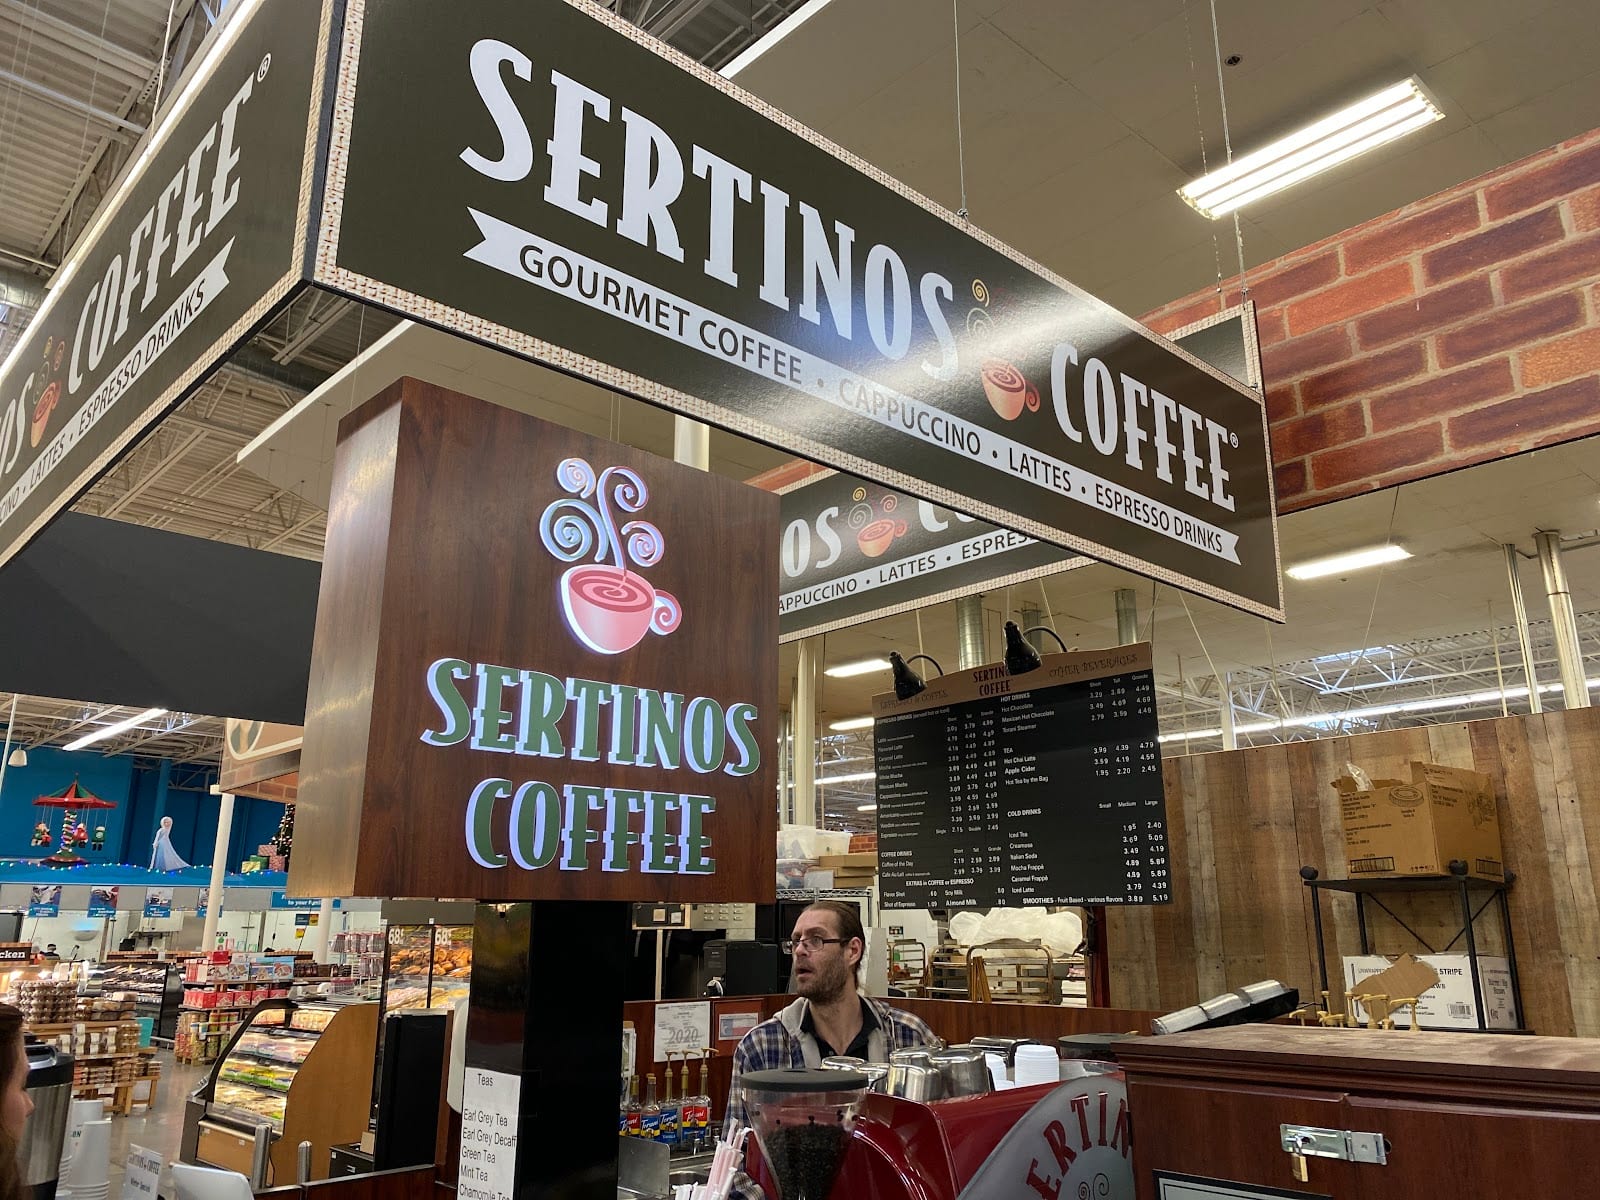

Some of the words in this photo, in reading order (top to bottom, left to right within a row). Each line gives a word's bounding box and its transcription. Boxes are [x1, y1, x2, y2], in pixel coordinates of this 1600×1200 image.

[459, 39, 960, 381] SERTINOS
[30, 433, 66, 490] LATTES
[79, 350, 141, 435] ESPRESSO
[145, 279, 206, 365] DRINKS
[519, 245, 690, 337] GOURMET
[699, 319, 803, 385] COFFEE
[838, 378, 981, 456] CAPPUCCINO
[1009, 447, 1072, 493] LATTES
[1096, 483, 1170, 532] ESPRESSO
[1174, 517, 1223, 554] DRINKS
[879, 554, 936, 583] LATTES
[979, 680, 1011, 697] COFFEE
[1001, 694, 1011, 702] HOT
[1011, 692, 1031, 701] DRINKS
[1010, 703, 1034, 712] Chocolate
[1135, 684, 1150, 692] 4.49
[420, 657, 760, 777] SERTINOS
[1001, 715, 1021, 724] Mexican
[1031, 710, 1055, 719] Chocolate
[1089, 702, 1104, 710] 3.49
[1136, 696, 1151, 704] 4.69
[1017, 723, 1037, 732] Steamer
[1137, 707, 1152, 715] 4.49
[1115, 744, 1130, 752] 4.39
[1139, 741, 1154, 749] 4.79
[1004, 767, 1020, 775] Apple
[1021, 765, 1036, 773] Cider
[1115, 755, 1130, 763] 4.19
[1140, 753, 1155, 761] 4.59
[1038, 775, 1049, 783] Bag
[1117, 767, 1131, 775] 2.20
[1141, 765, 1157, 773] 2.45
[1007, 809, 1021, 818] COLD
[1022, 807, 1042, 816] DRINKS
[1117, 800, 1137, 808] Medium
[465, 778, 716, 875] COFFEE
[1008, 831, 1019, 839] Iced
[1147, 821, 1162, 829] 2.40
[1122, 835, 1138, 844] 3.69
[1148, 834, 1164, 842] 5.09
[1010, 853, 1024, 861] Italian
[1024, 852, 1038, 860] Soda
[1123, 847, 1139, 855] 3.49
[1149, 845, 1165, 853] 4.19
[1010, 864, 1028, 872] Mocha
[1011, 875, 1031, 883] Caramel
[1150, 869, 1167, 878] 5.89
[927, 879, 945, 887] COFFEE
[1022, 886, 1035, 894] Latte
[1126, 882, 1142, 891] 3.79
[1151, 881, 1167, 890] 4.39
[945, 899, 966, 907] Almond
[1022, 897, 1054, 905] SMOOTHIES
[1057, 896, 1069, 904] Fruit
[1068, 896, 1084, 904] Based
[1105, 895, 1124, 903] flavors
[1127, 894, 1143, 903] 3.89
[1152, 893, 1168, 902] 5.19
[1439, 968, 1463, 976] STRIPE
[665, 1026, 699, 1045] 2020
[477, 1073, 494, 1087] Teas
[463, 1108, 477, 1121] Earl
[477, 1110, 494, 1127] Grey
[495, 1113, 508, 1127] Tea
[462, 1127, 476, 1140] Earl
[476, 1129, 493, 1147] Grey
[461, 1145, 481, 1161] Green
[483, 1149, 496, 1164] Tea
[460, 1165, 474, 1180] Mint
[475, 1167, 488, 1182] Tea
